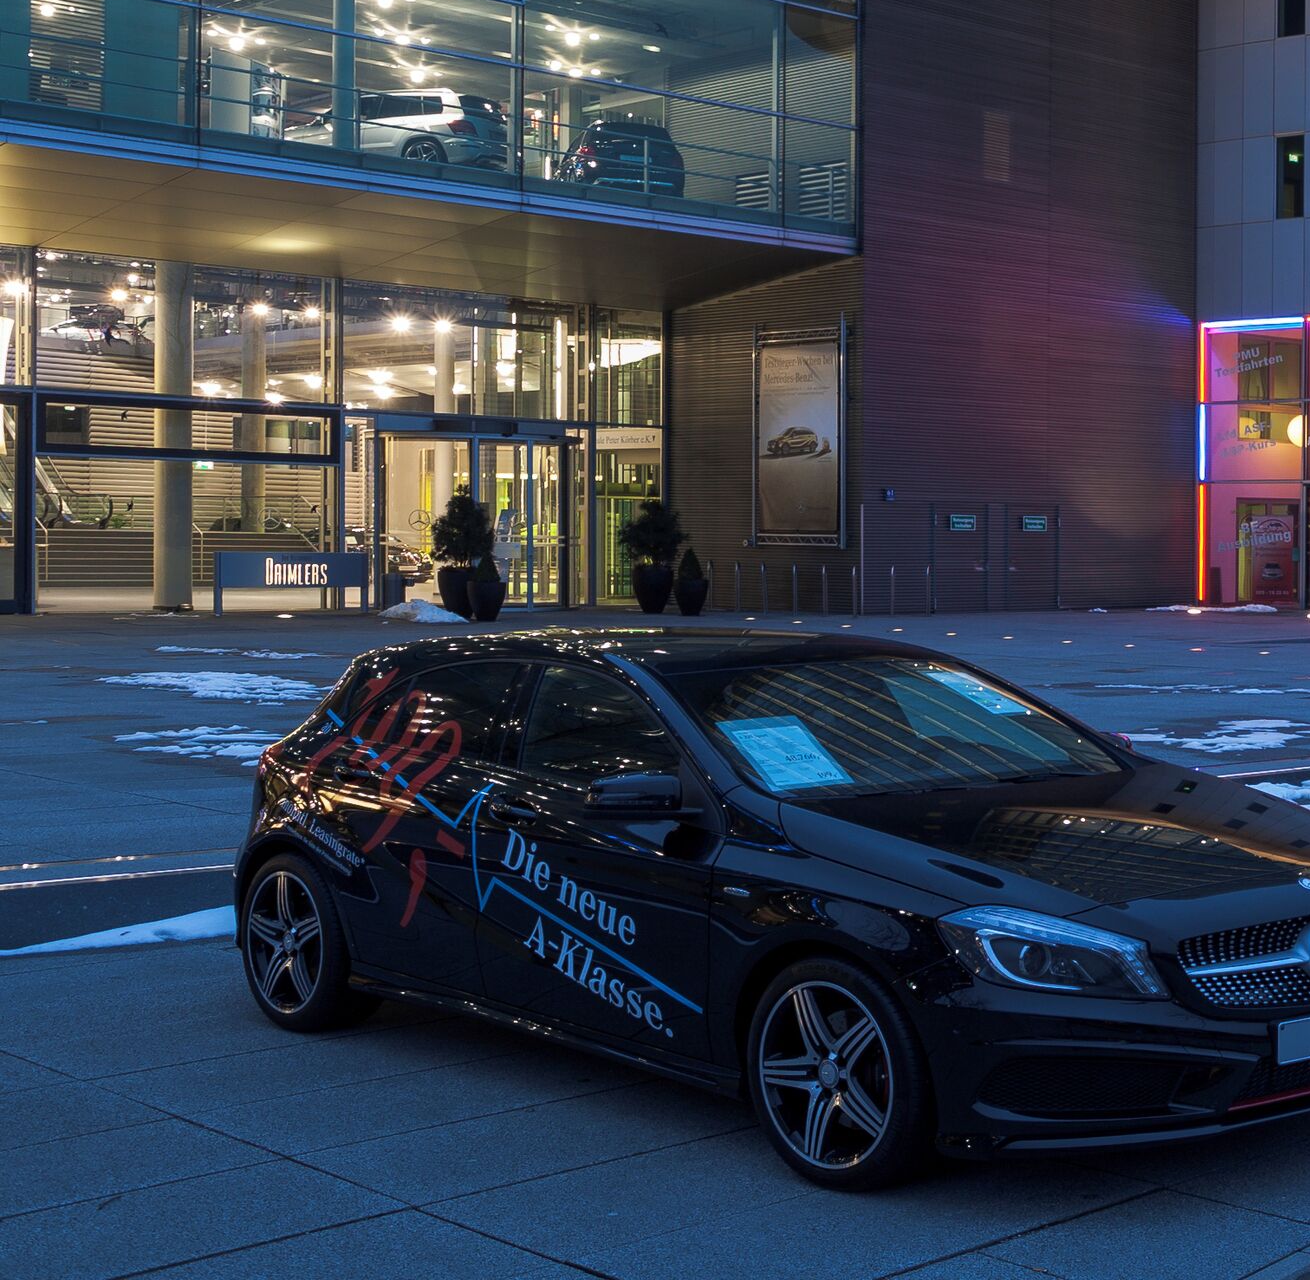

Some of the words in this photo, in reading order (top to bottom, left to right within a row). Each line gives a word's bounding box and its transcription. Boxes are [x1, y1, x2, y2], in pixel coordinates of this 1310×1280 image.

[501, 828, 550, 891] Die
[556, 875, 636, 946] neue
[522, 915, 674, 1038] A-Klasse.
